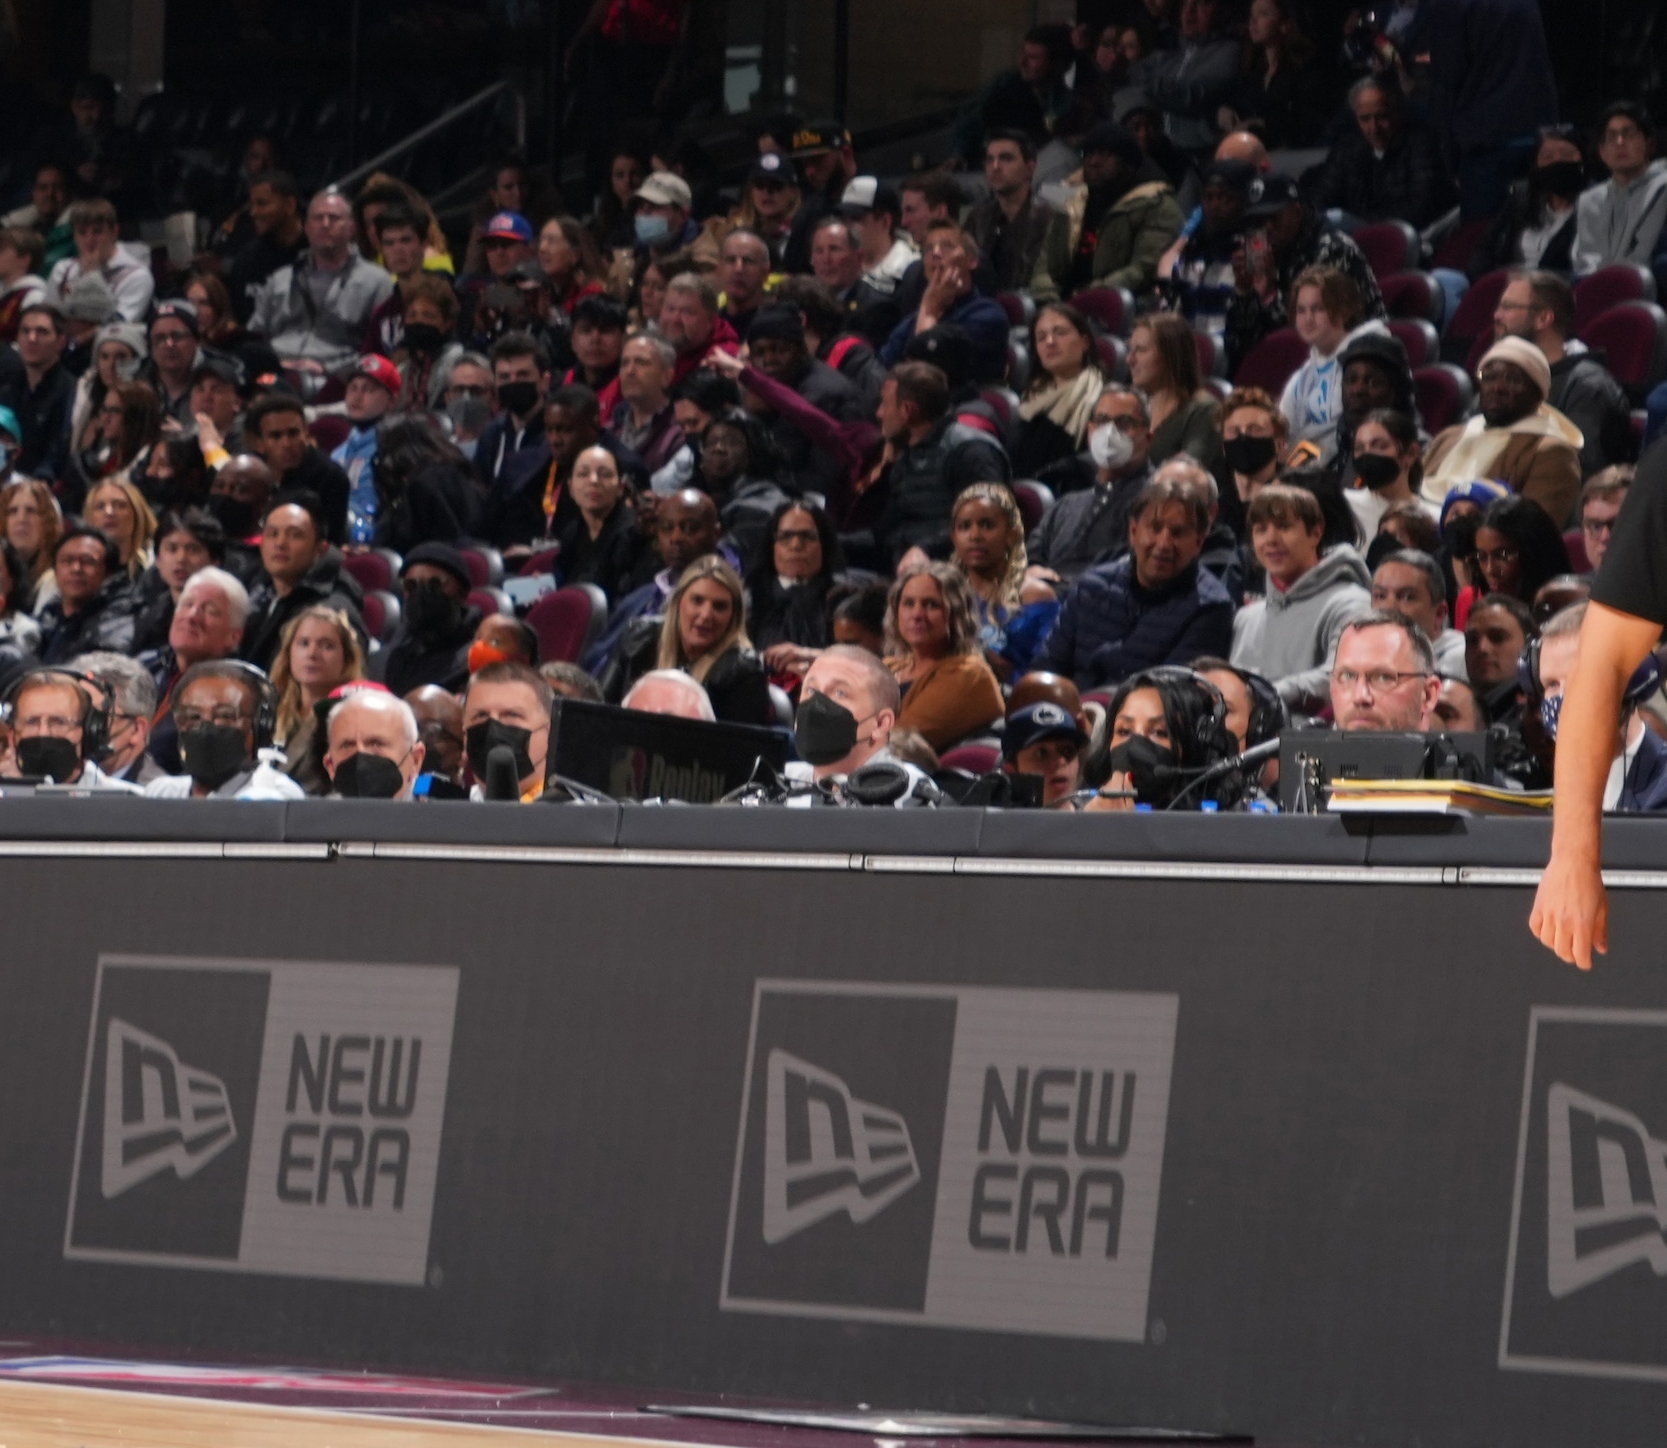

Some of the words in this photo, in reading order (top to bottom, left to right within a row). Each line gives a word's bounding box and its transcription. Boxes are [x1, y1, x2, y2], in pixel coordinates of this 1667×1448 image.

[285, 1032, 423, 1119] NEW
[977, 1063, 1137, 1160] NEW
[275, 1122, 411, 1211] ERA
[967, 1163, 1125, 1262] ERA
